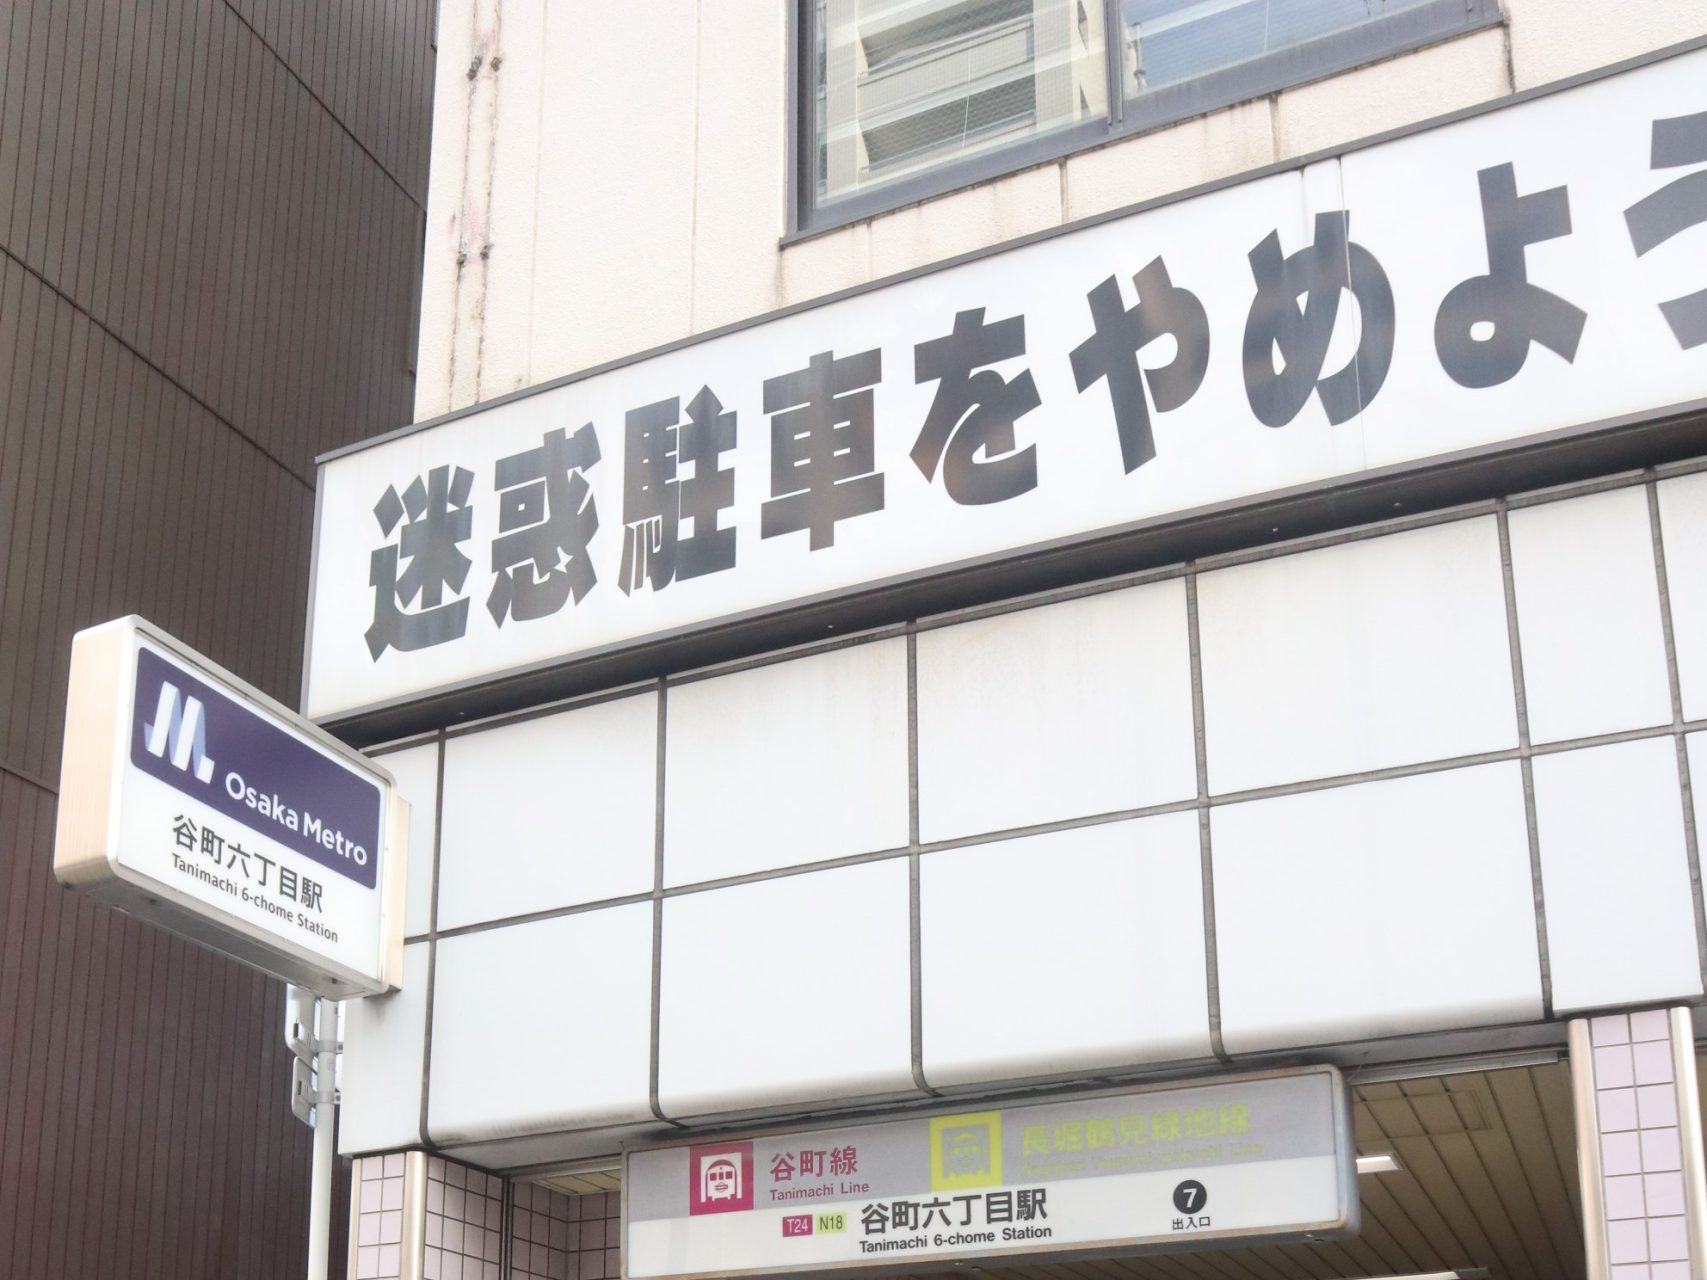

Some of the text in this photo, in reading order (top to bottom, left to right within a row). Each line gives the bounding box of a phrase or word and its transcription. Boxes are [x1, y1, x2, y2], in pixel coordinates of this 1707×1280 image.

[225, 772, 367, 866] Osaka Metro
[171, 813, 323, 914] 谷町六丁目駅
[171, 853, 338, 943] Tanimachi 6-chome Station
[769, 1145, 859, 1183] 谷町線
[769, 1181, 870, 1201] Tanimachi Line
[1183, 1188, 1197, 1208] 7
[786, 1215, 843, 1234] T24 N18
[860, 1188, 1048, 1236] 谷町六丁目駅
[1172, 1216, 1210, 1230] 出入口
[859, 1225, 1052, 1253] Tanimachi 6-chome Station
